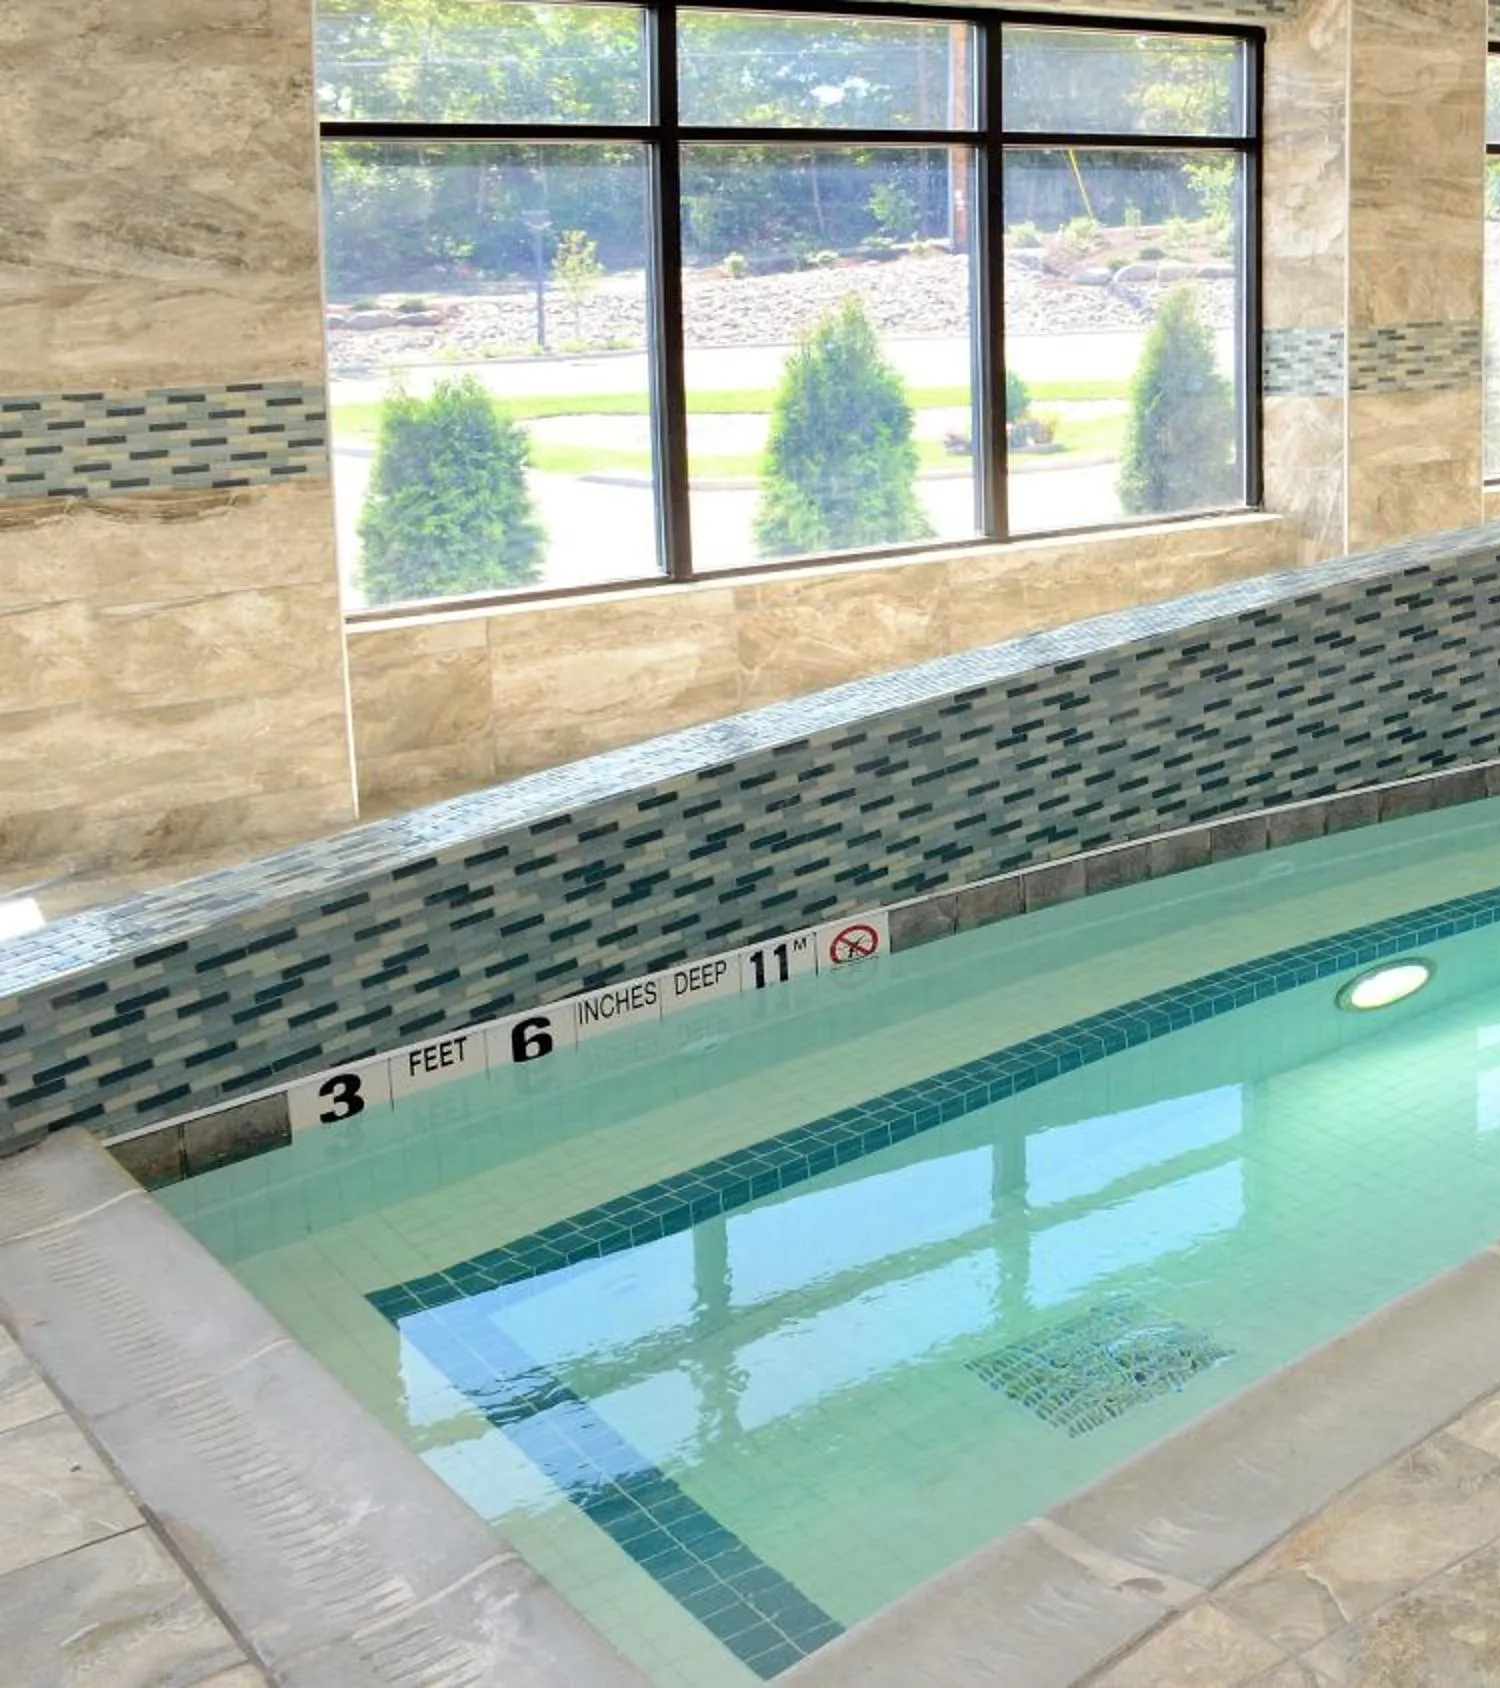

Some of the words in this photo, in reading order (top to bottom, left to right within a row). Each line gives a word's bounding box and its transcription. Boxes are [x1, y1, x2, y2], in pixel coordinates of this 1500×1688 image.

[319, 1073, 365, 1124] 3
[409, 1036, 467, 1076] FEET
[511, 1016, 553, 1063] 6
[578, 981, 657, 1025] INCHES
[674, 960, 728, 996] DEEP
[793, 937, 807, 951] M
